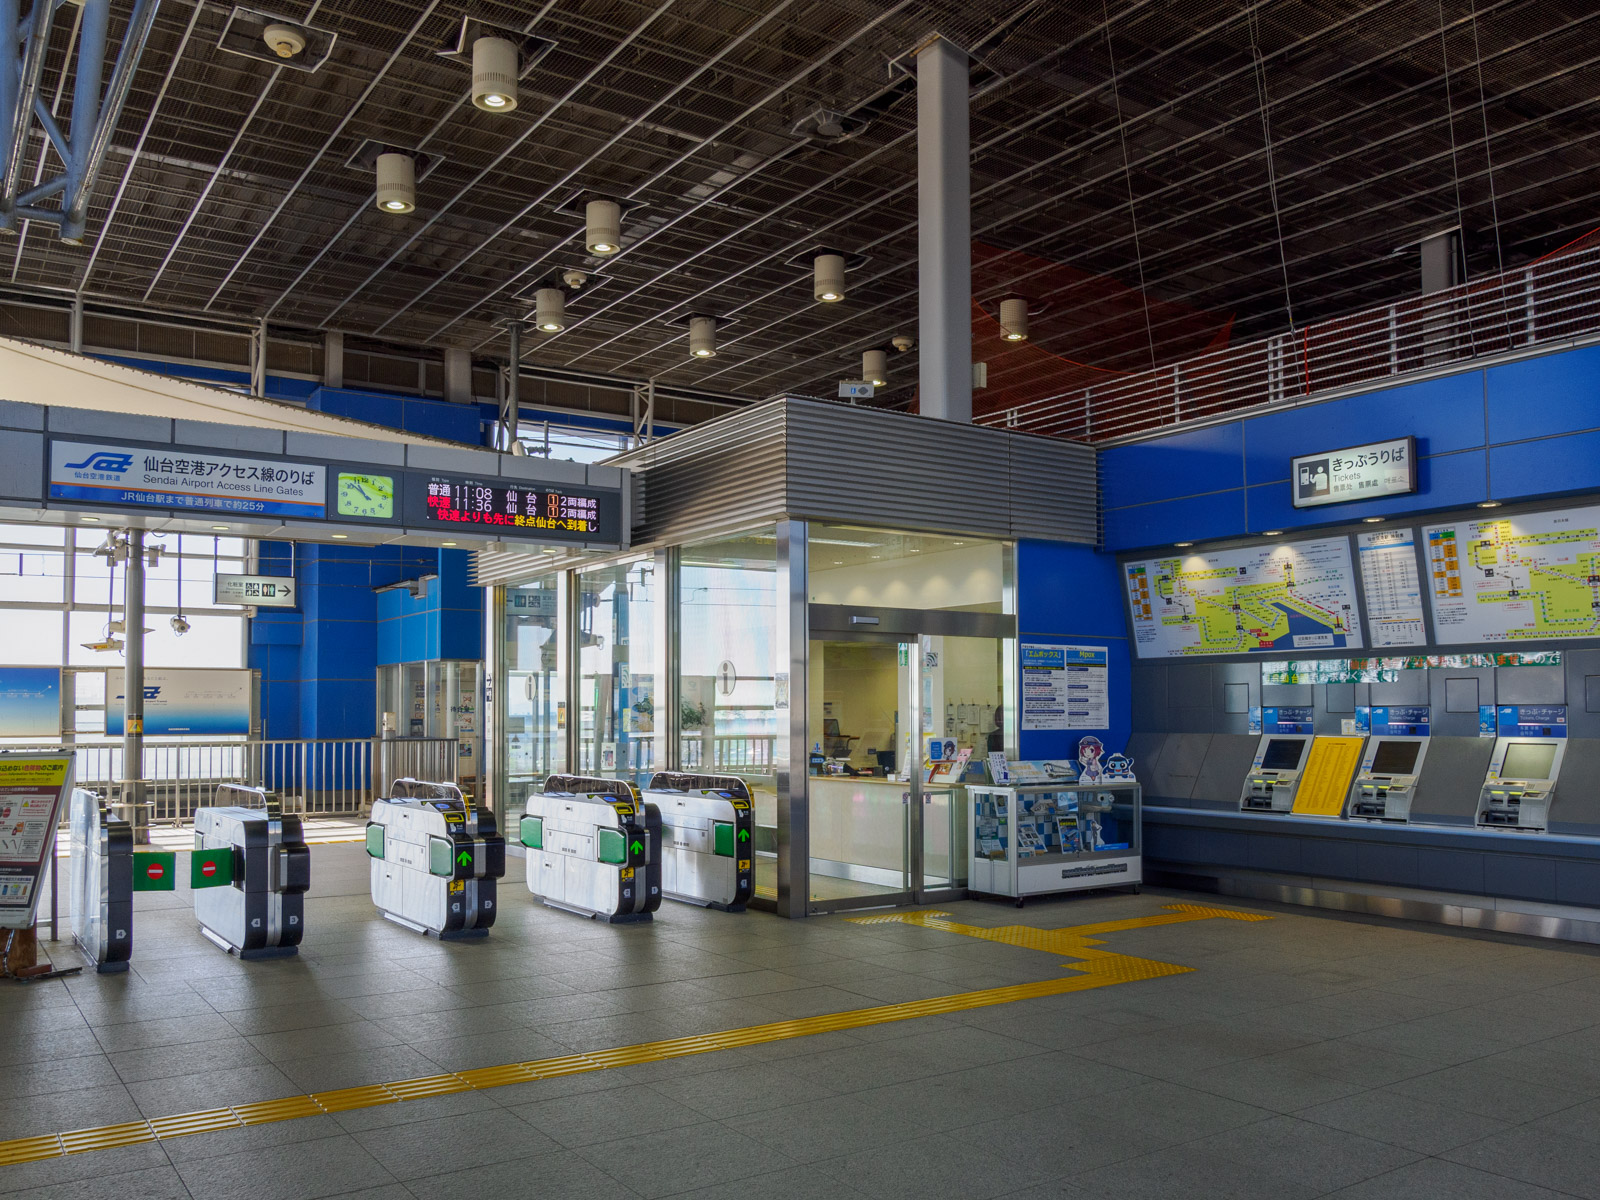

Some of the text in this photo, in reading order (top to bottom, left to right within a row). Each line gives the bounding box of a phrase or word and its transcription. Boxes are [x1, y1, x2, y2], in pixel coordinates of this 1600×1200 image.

[1332, 446, 1405, 472] きっぷうりば
[74, 470, 121, 482] 仙台空港鉄道
[143, 455, 315, 487] 仙台空港アクセス線のりば
[1332, 472, 1361, 483] Tickets
[143, 474, 304, 497] Sendai Airport Access Line Gates
[427, 483, 451, 497] 普通
[454, 485, 493, 501] 11:08
[560, 495, 597, 509] 2両編成
[120, 490, 266, 513] JR仙台駅まで普通列車で約25分
[427, 496, 451, 510] 快速
[454, 497, 493, 513] 11:36
[560, 507, 597, 521] 2両編成
[1079, 651, 1095, 660] Mpox
